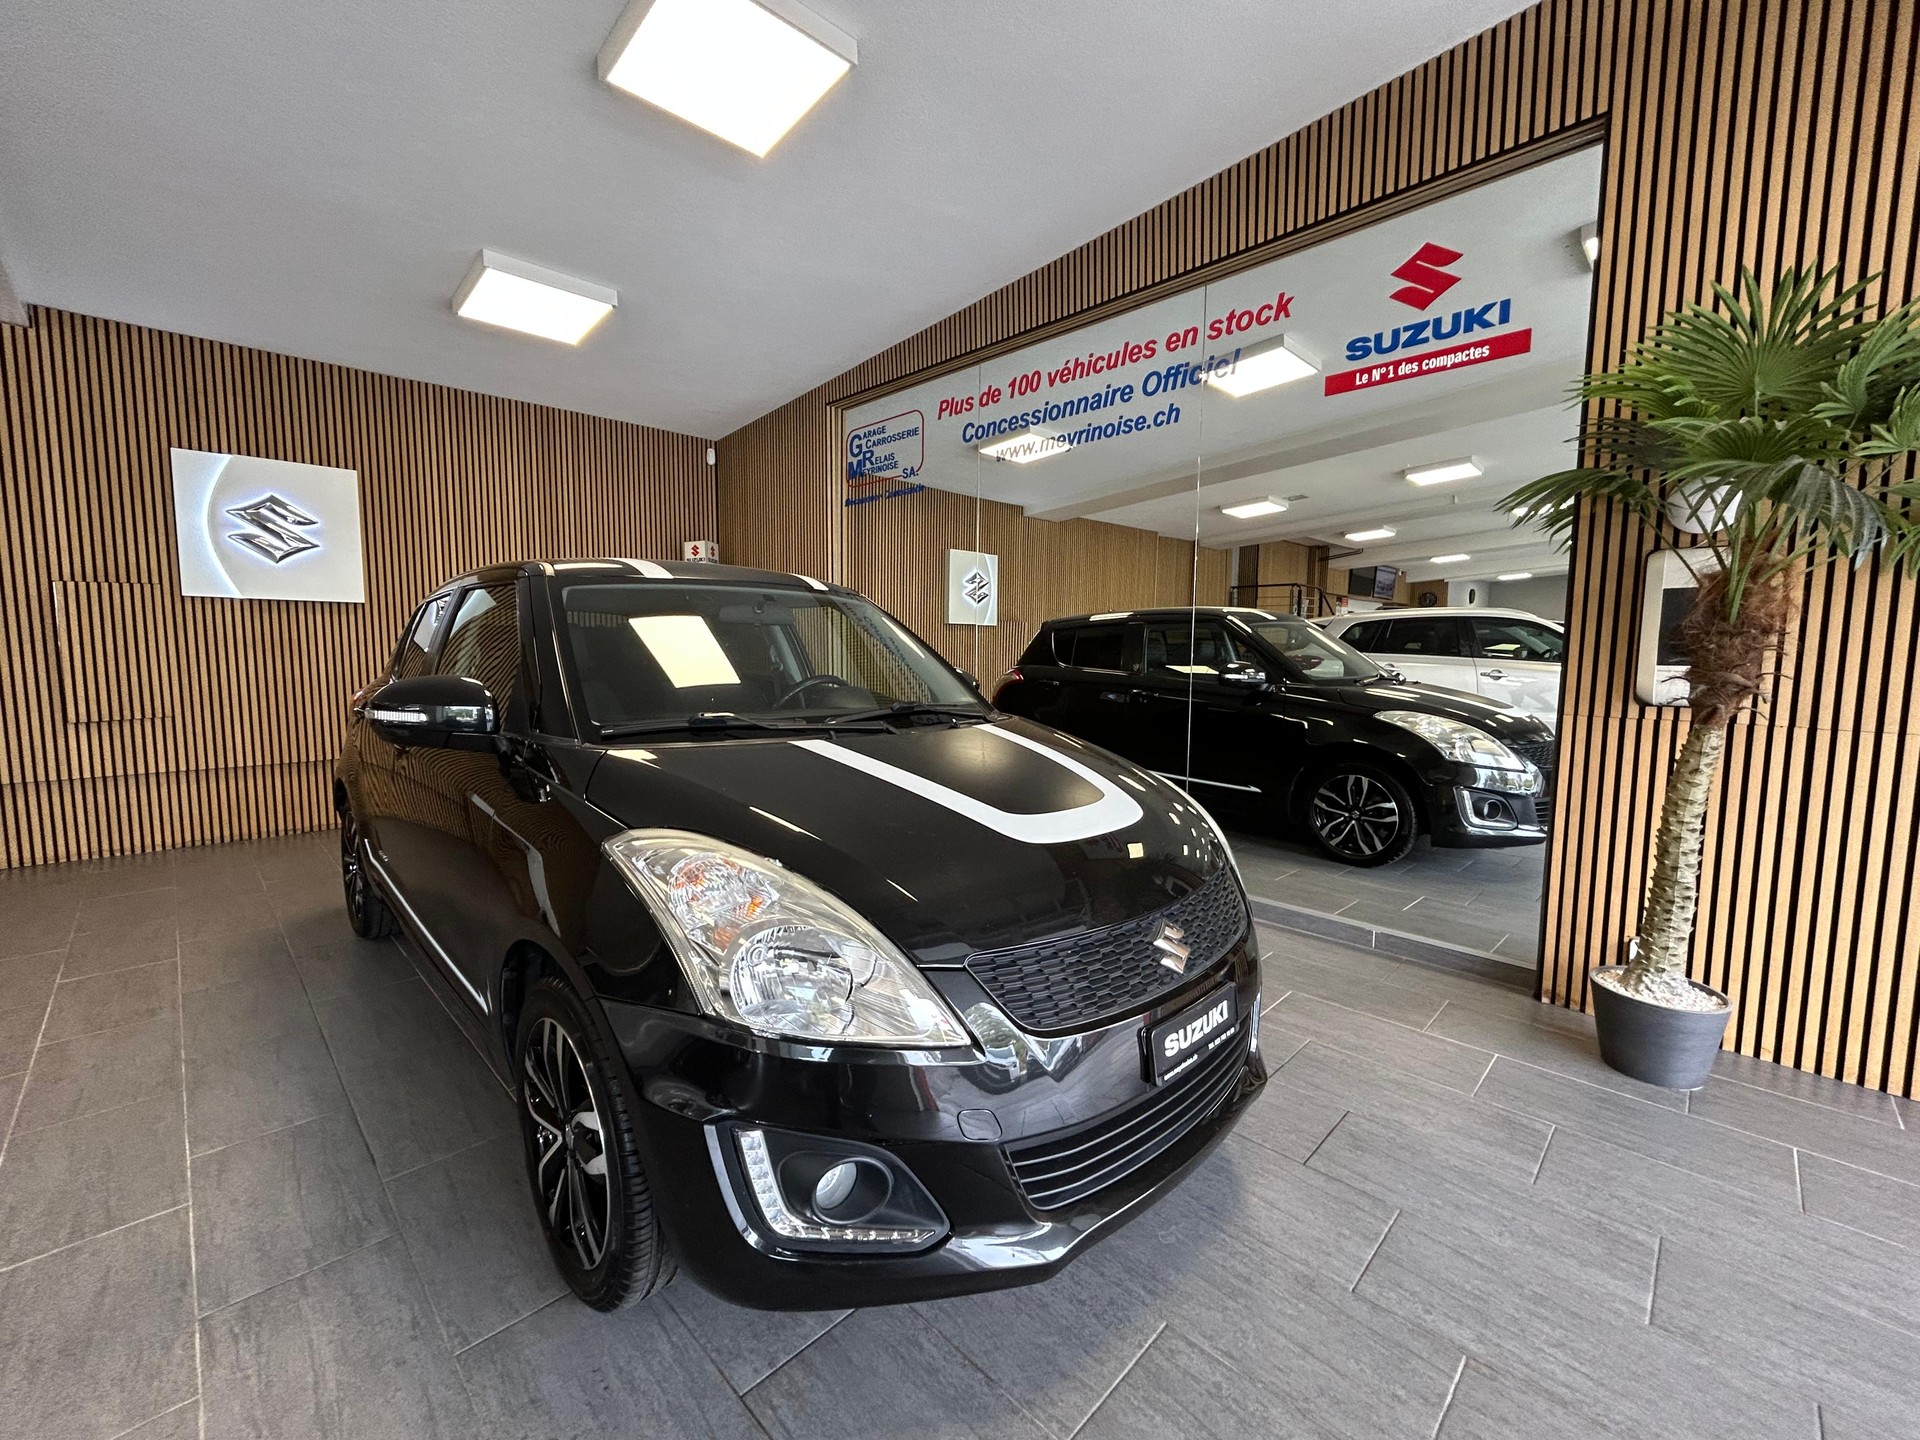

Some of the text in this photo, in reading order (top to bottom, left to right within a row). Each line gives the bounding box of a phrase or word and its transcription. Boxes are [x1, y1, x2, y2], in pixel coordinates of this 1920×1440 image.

[937, 292, 1295, 420] Plus de 100 véhicules en stock
[1345, 299, 1511, 361] SUZUKI
[1355, 372, 1369, 385] Le
[1398, 358, 1419, 376] des
[1422, 345, 1490, 371] compactes
[962, 348, 1241, 443] Concessionnaire Officiel
[849, 426, 887, 458] GARAGE
[862, 449, 895, 468] RELAIS
[865, 427, 920, 449] CARROSSERIE
[996, 403, 1181, 462] www.meyrinoise.ch
[1164, 1000, 1229, 1058] SUZUKI
